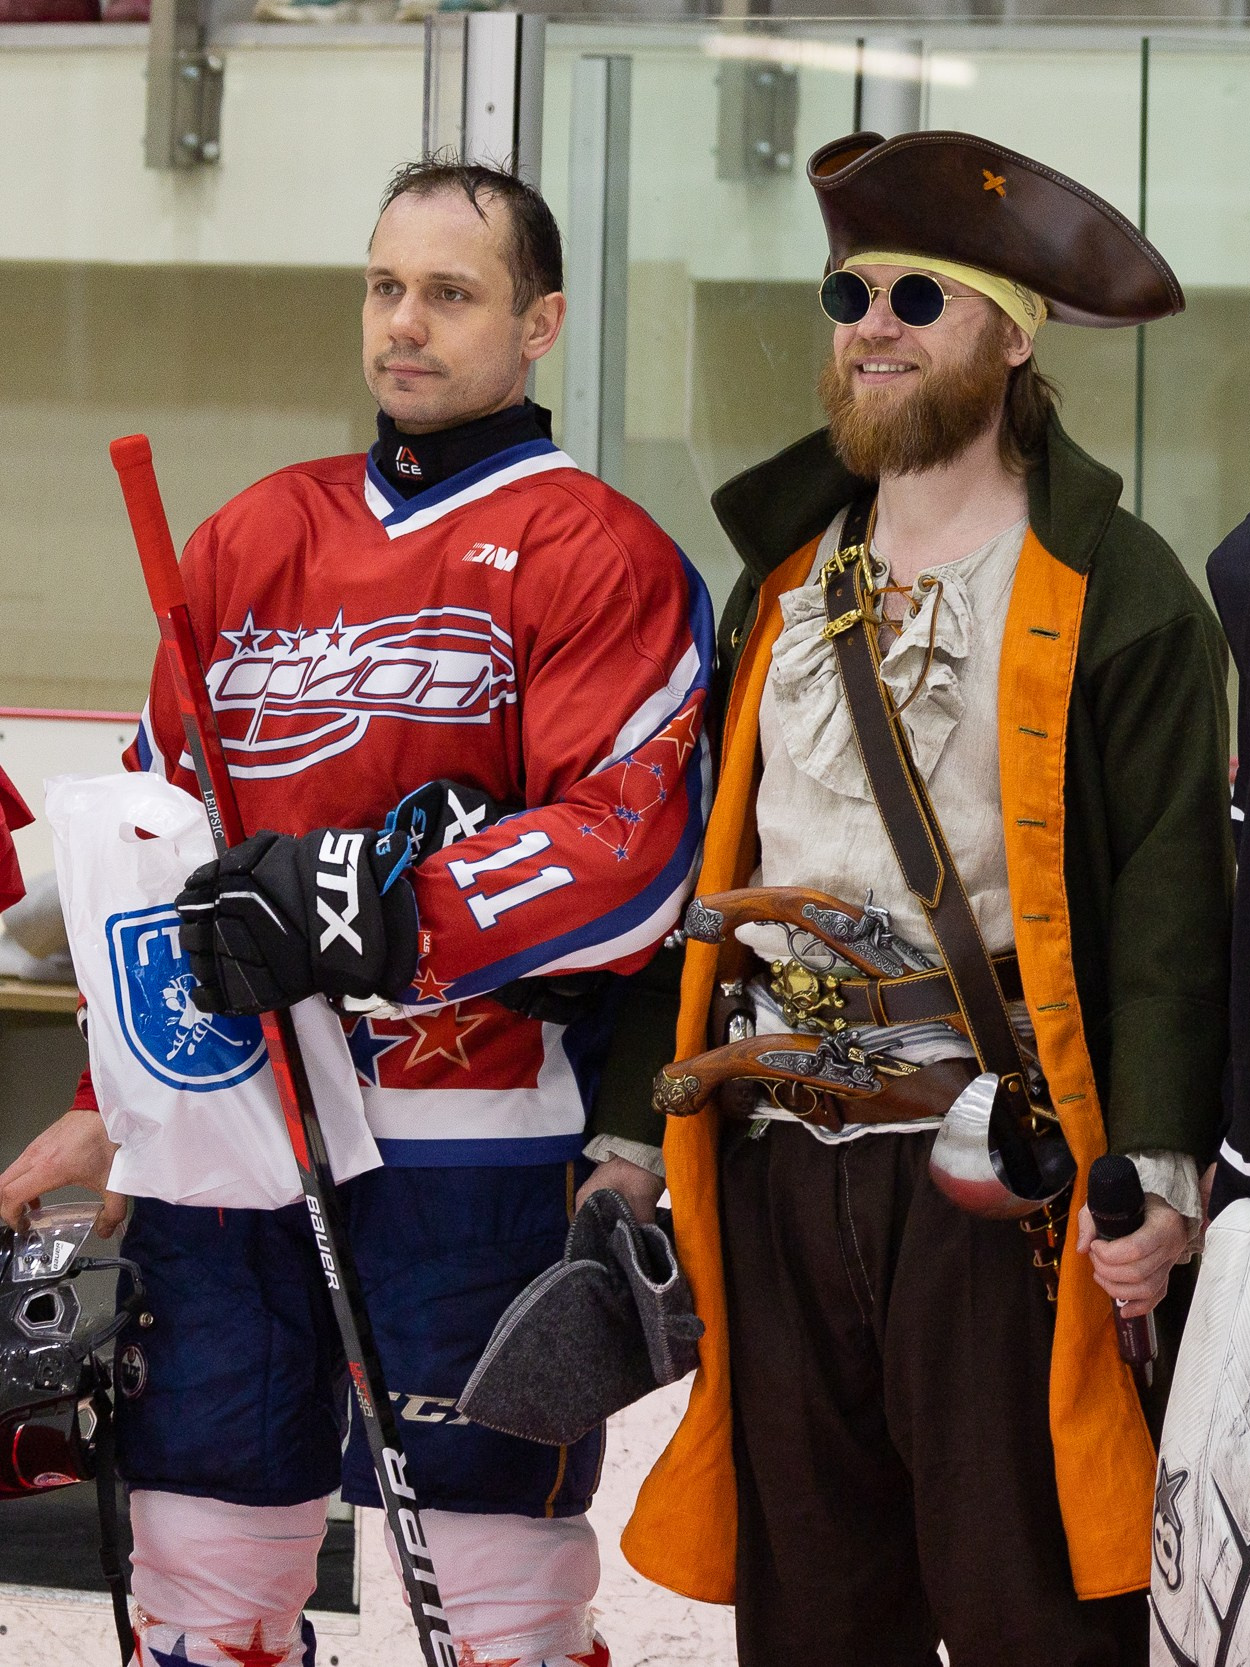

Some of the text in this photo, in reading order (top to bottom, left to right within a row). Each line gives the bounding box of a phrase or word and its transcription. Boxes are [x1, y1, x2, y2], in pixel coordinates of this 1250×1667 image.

[396, 461, 422, 475] ICE
[203, 790, 225, 839] LEIPSIC
[316, 830, 365, 955] STX
[447, 830, 577, 932] 11
[306, 1194, 340, 1290] BAUER
